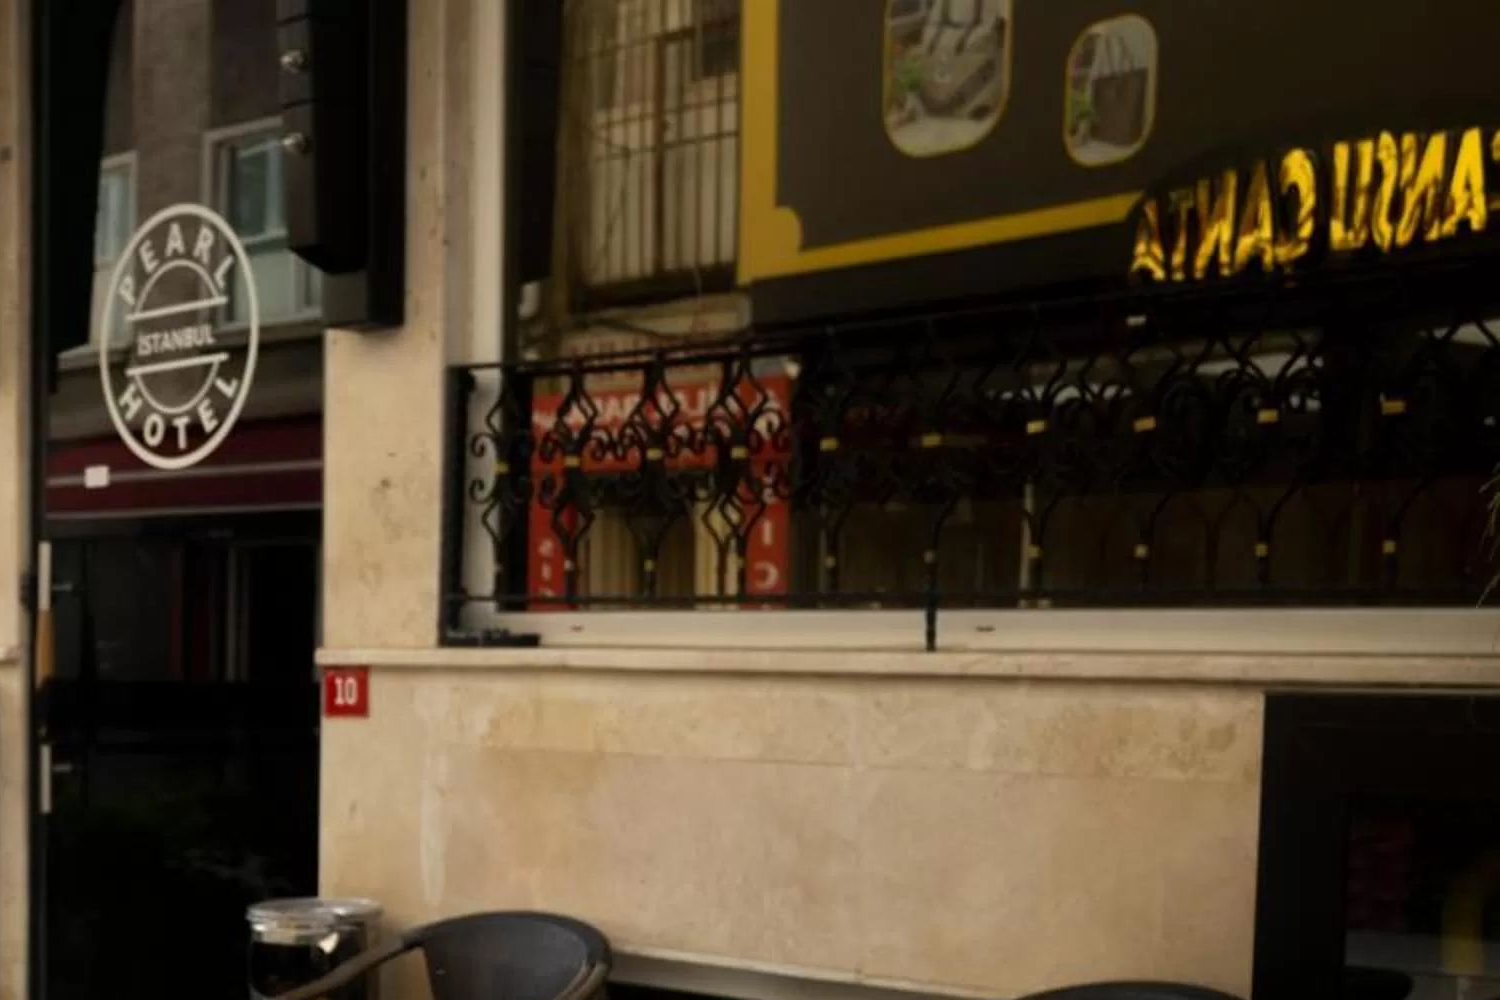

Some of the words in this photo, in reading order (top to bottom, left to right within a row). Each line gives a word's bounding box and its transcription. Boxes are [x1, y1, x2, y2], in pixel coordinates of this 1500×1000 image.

[119, 222, 234, 306] PEARL
[119, 376, 238, 450] HOTEL
[334, 676, 358, 705] 10
